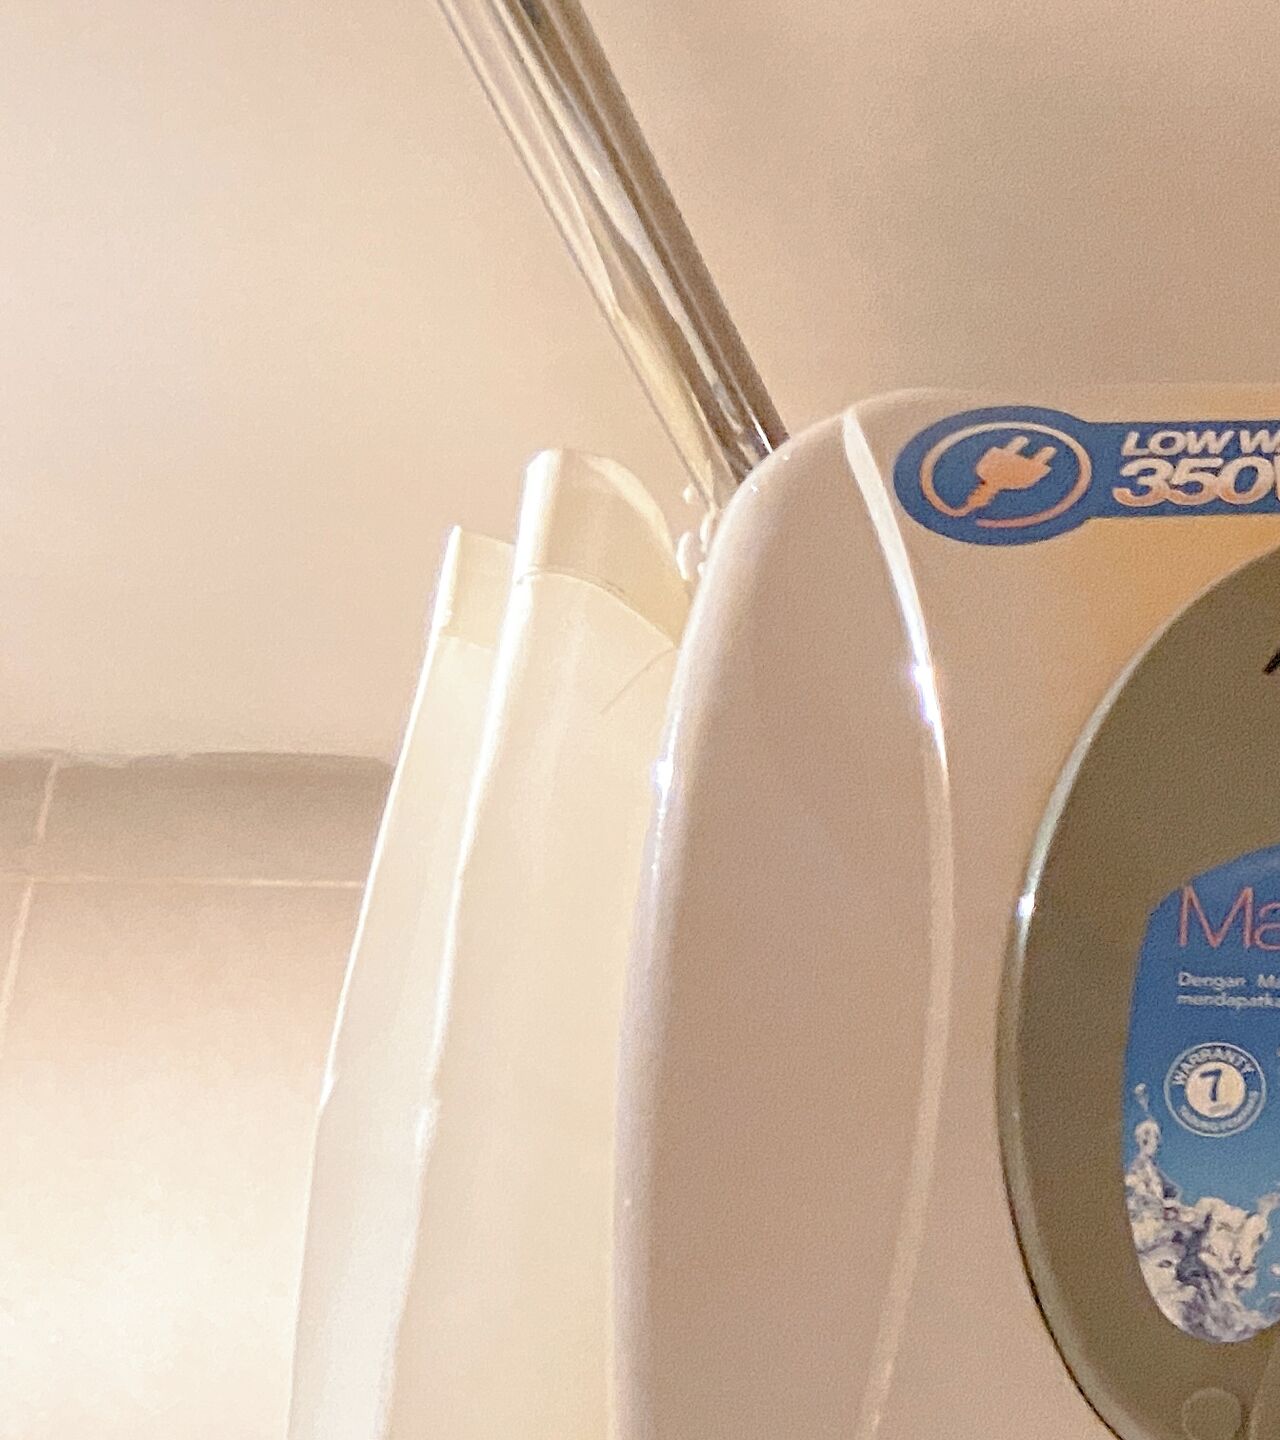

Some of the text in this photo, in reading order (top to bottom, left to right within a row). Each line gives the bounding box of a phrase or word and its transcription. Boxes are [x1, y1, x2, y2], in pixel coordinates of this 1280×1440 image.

[1120, 430, 1235, 456] LOW
[1178, 971, 1247, 990] Dengan
[1199, 1068, 1223, 1102] 7
